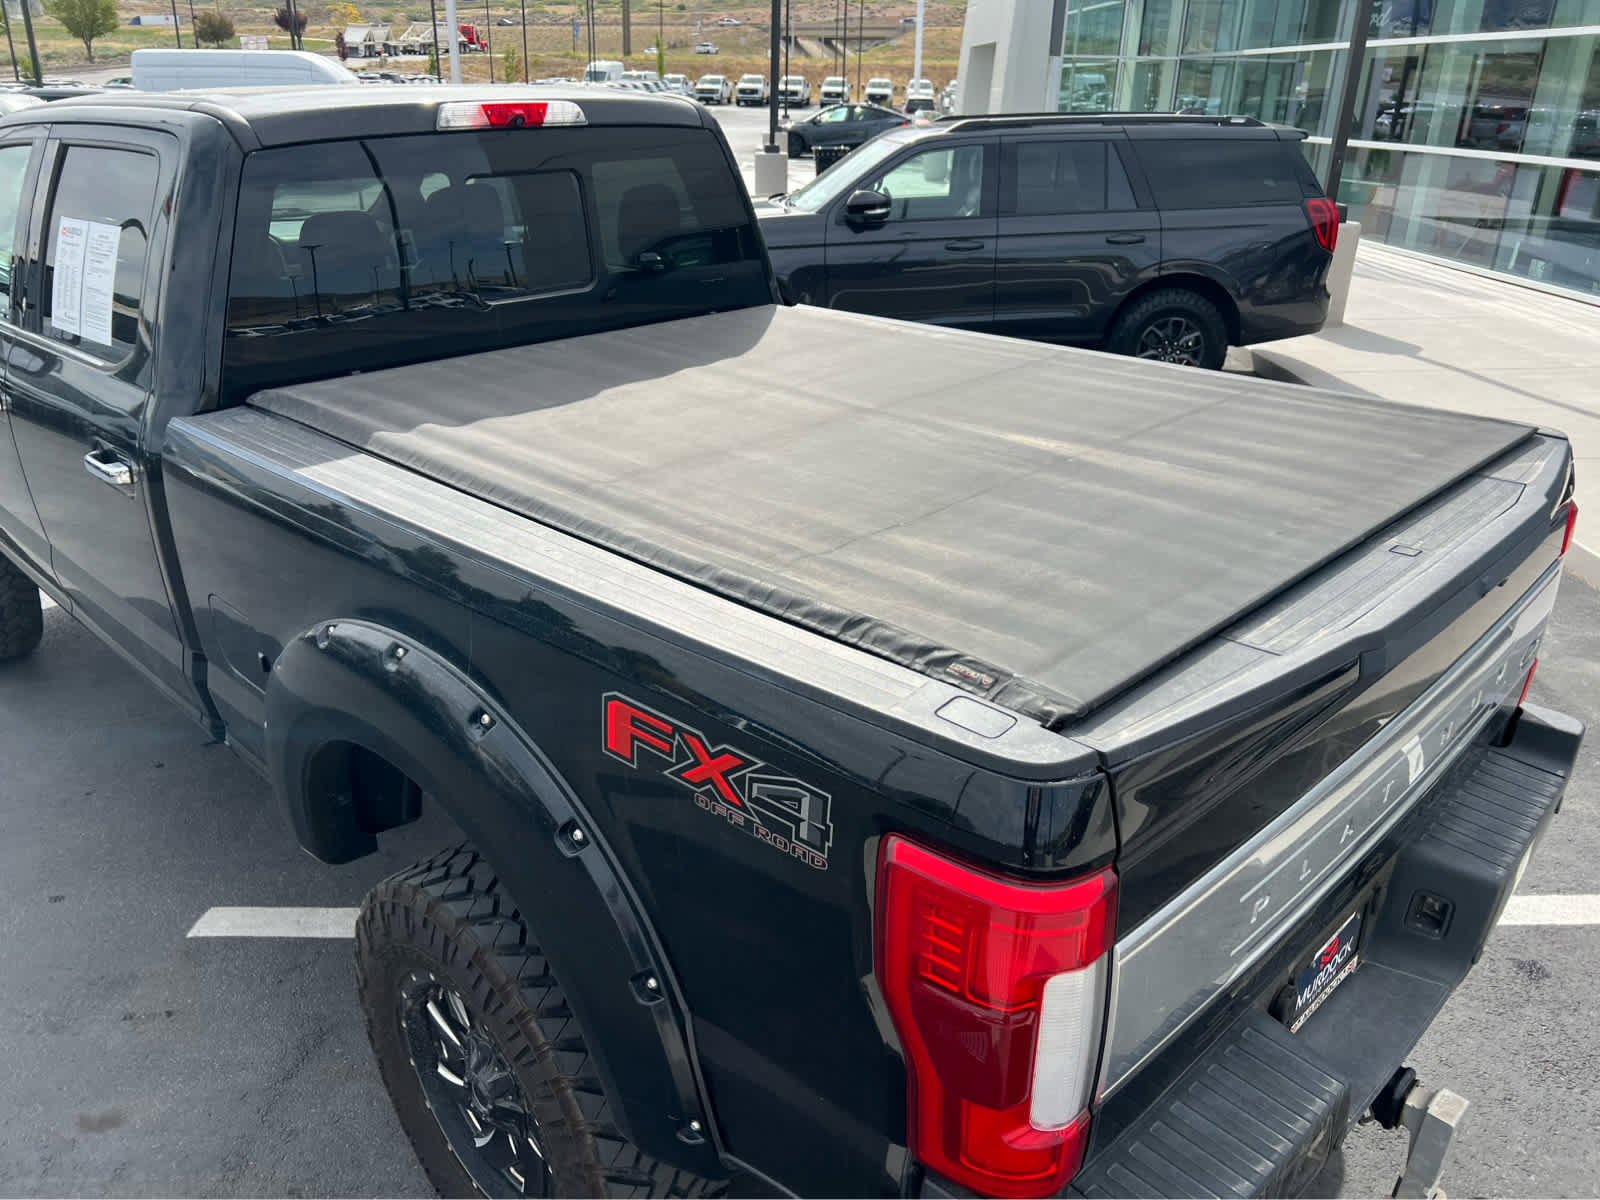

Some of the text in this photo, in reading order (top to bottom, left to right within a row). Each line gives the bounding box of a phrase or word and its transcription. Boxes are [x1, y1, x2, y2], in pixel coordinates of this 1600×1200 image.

[602, 691, 833, 858] FX4
[694, 792, 829, 870] OFF ROAD
[1295, 935, 1354, 1011] MURDOCK
